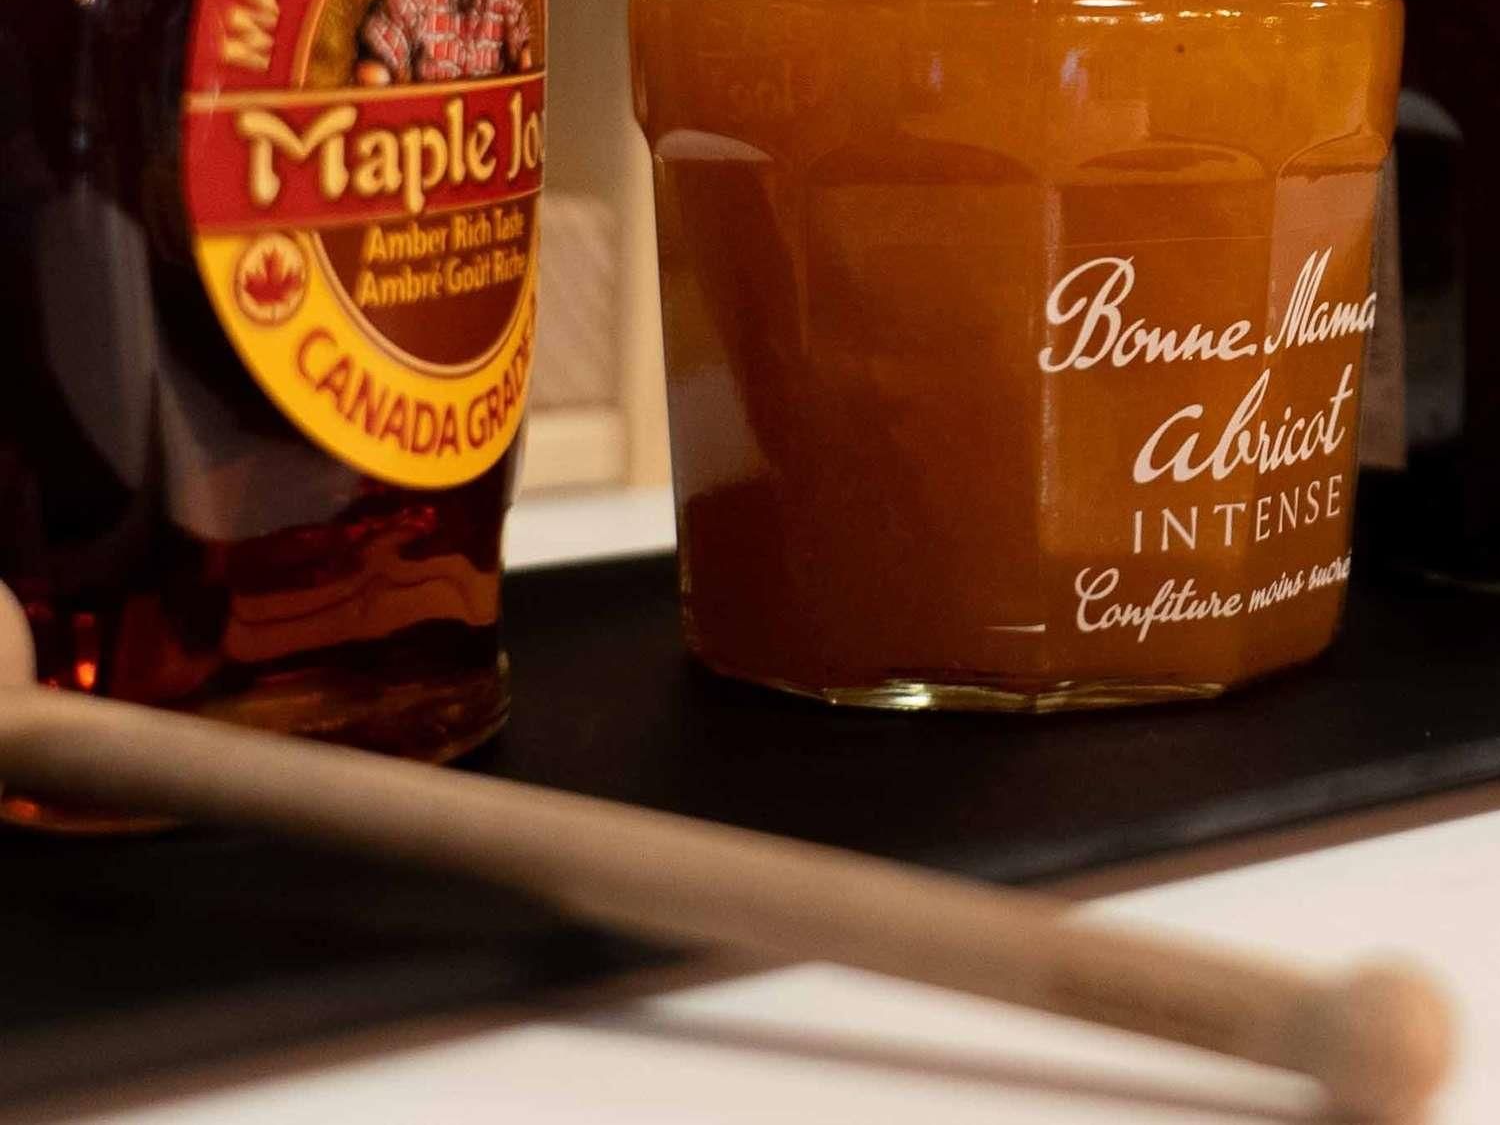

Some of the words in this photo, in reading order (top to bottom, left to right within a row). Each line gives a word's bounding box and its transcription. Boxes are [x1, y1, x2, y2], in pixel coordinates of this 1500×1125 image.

[236, 97, 497, 215] Maple
[366, 222, 449, 264] Amber
[453, 213, 493, 251] Rich
[359, 261, 444, 307] Ambré
[445, 254, 491, 295] Goût
[1039, 256, 1258, 373] Bonne
[296, 327, 462, 457] CANADA
[1133, 474, 1344, 555] INTENSE
[1074, 566, 1244, 644] Confiture
[1247, 571, 1305, 614] moins
